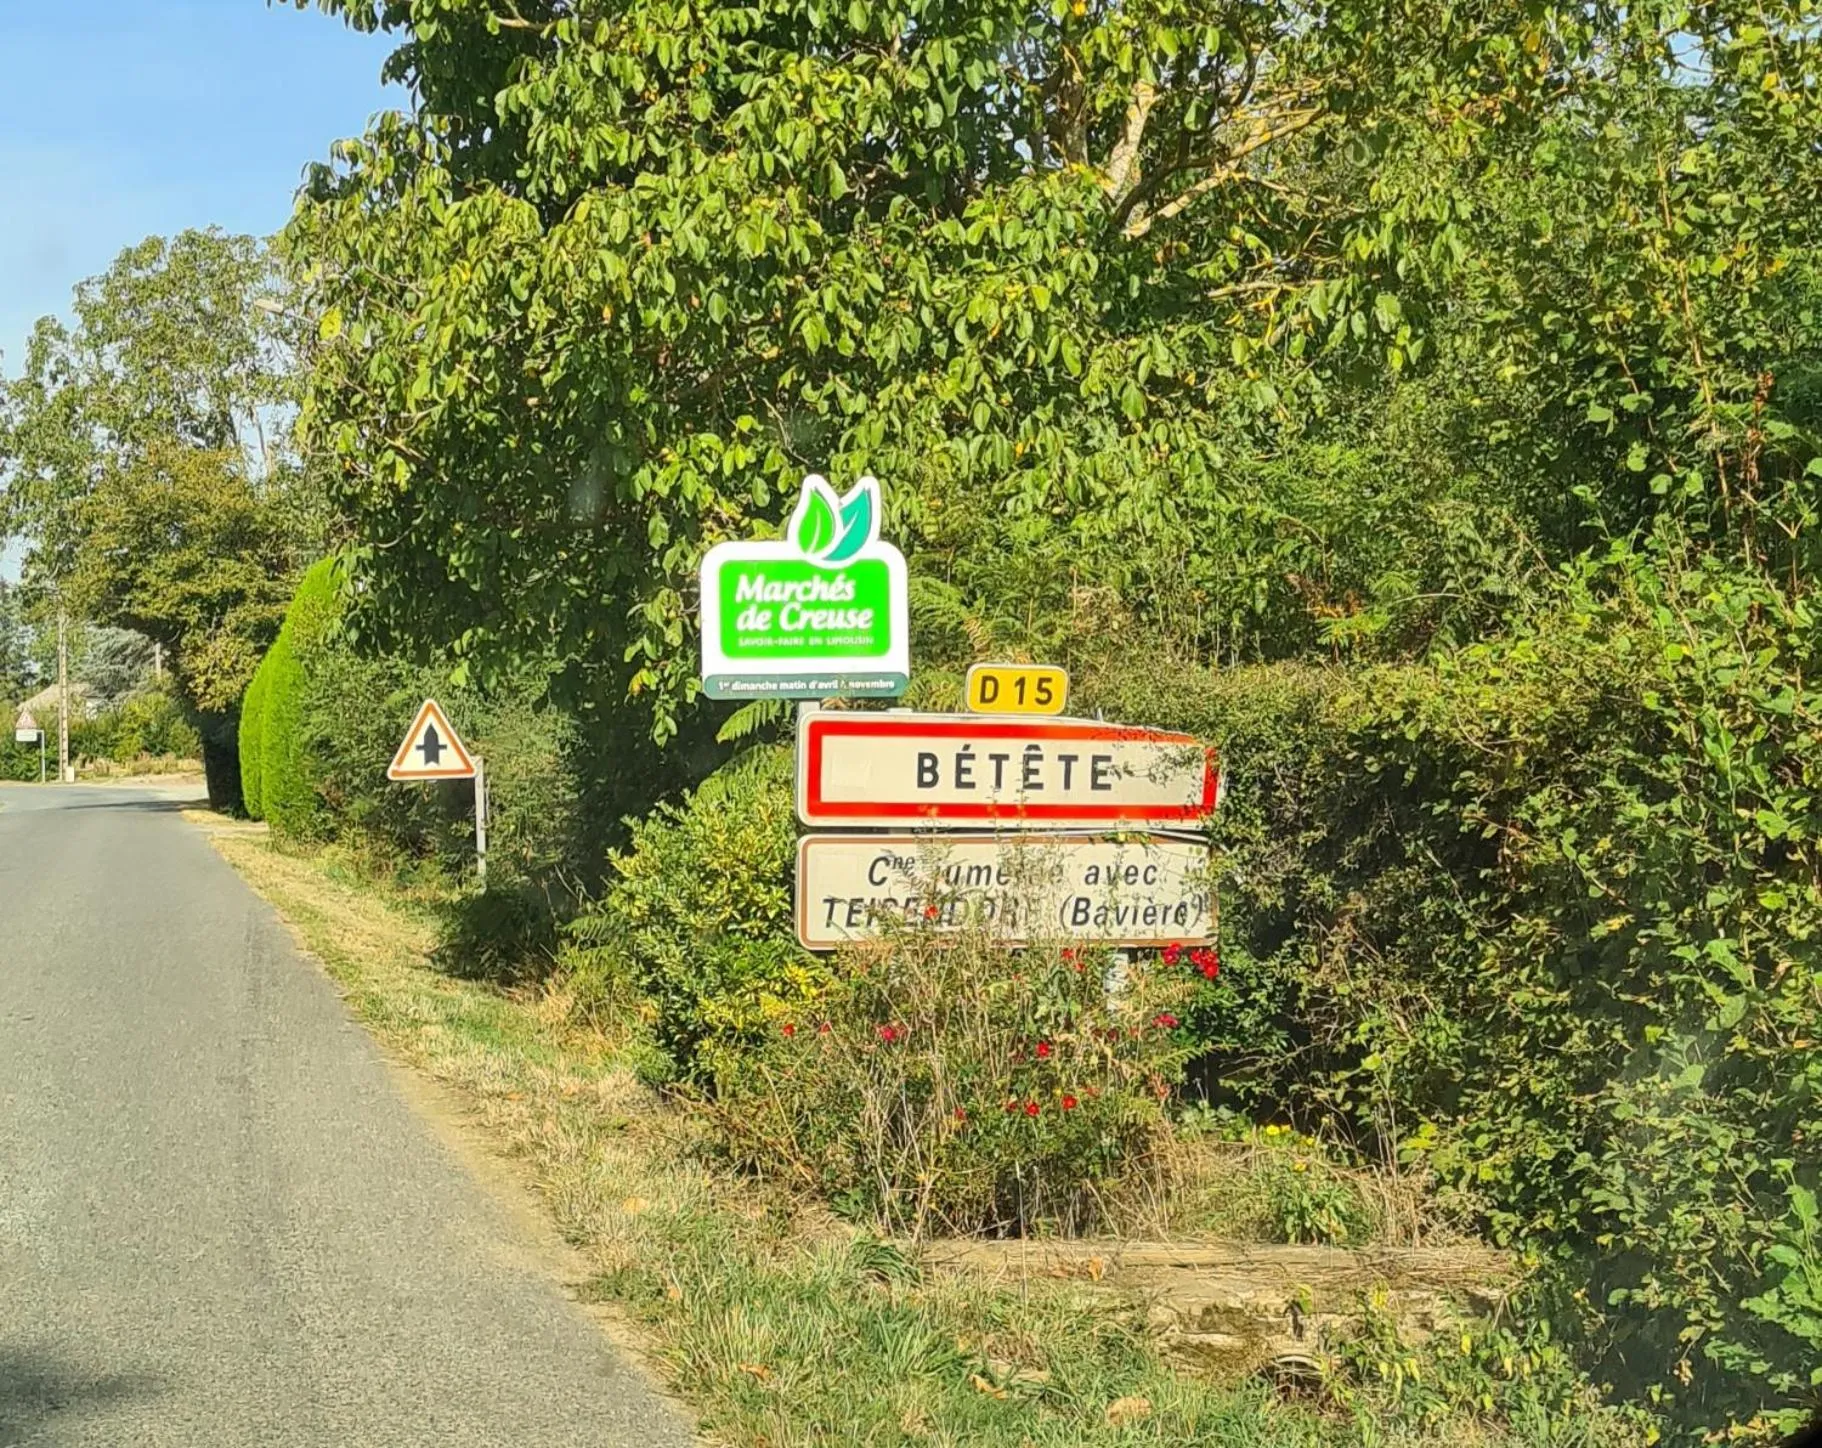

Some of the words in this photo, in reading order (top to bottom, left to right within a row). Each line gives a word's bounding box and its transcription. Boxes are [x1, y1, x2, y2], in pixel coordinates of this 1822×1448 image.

[735, 572, 856, 603] Marchés
[736, 603, 772, 632] de
[779, 602, 875, 632] Creuse
[732, 680, 778, 691] dimanche
[779, 680, 807, 690] matin
[979, 675, 1000, 704] D
[1014, 676, 1053, 706] 15
[916, 743, 1113, 791] BÉTÊTE
[1084, 864, 1158, 886] avec
[1060, 893, 1203, 929] (Bavière)
